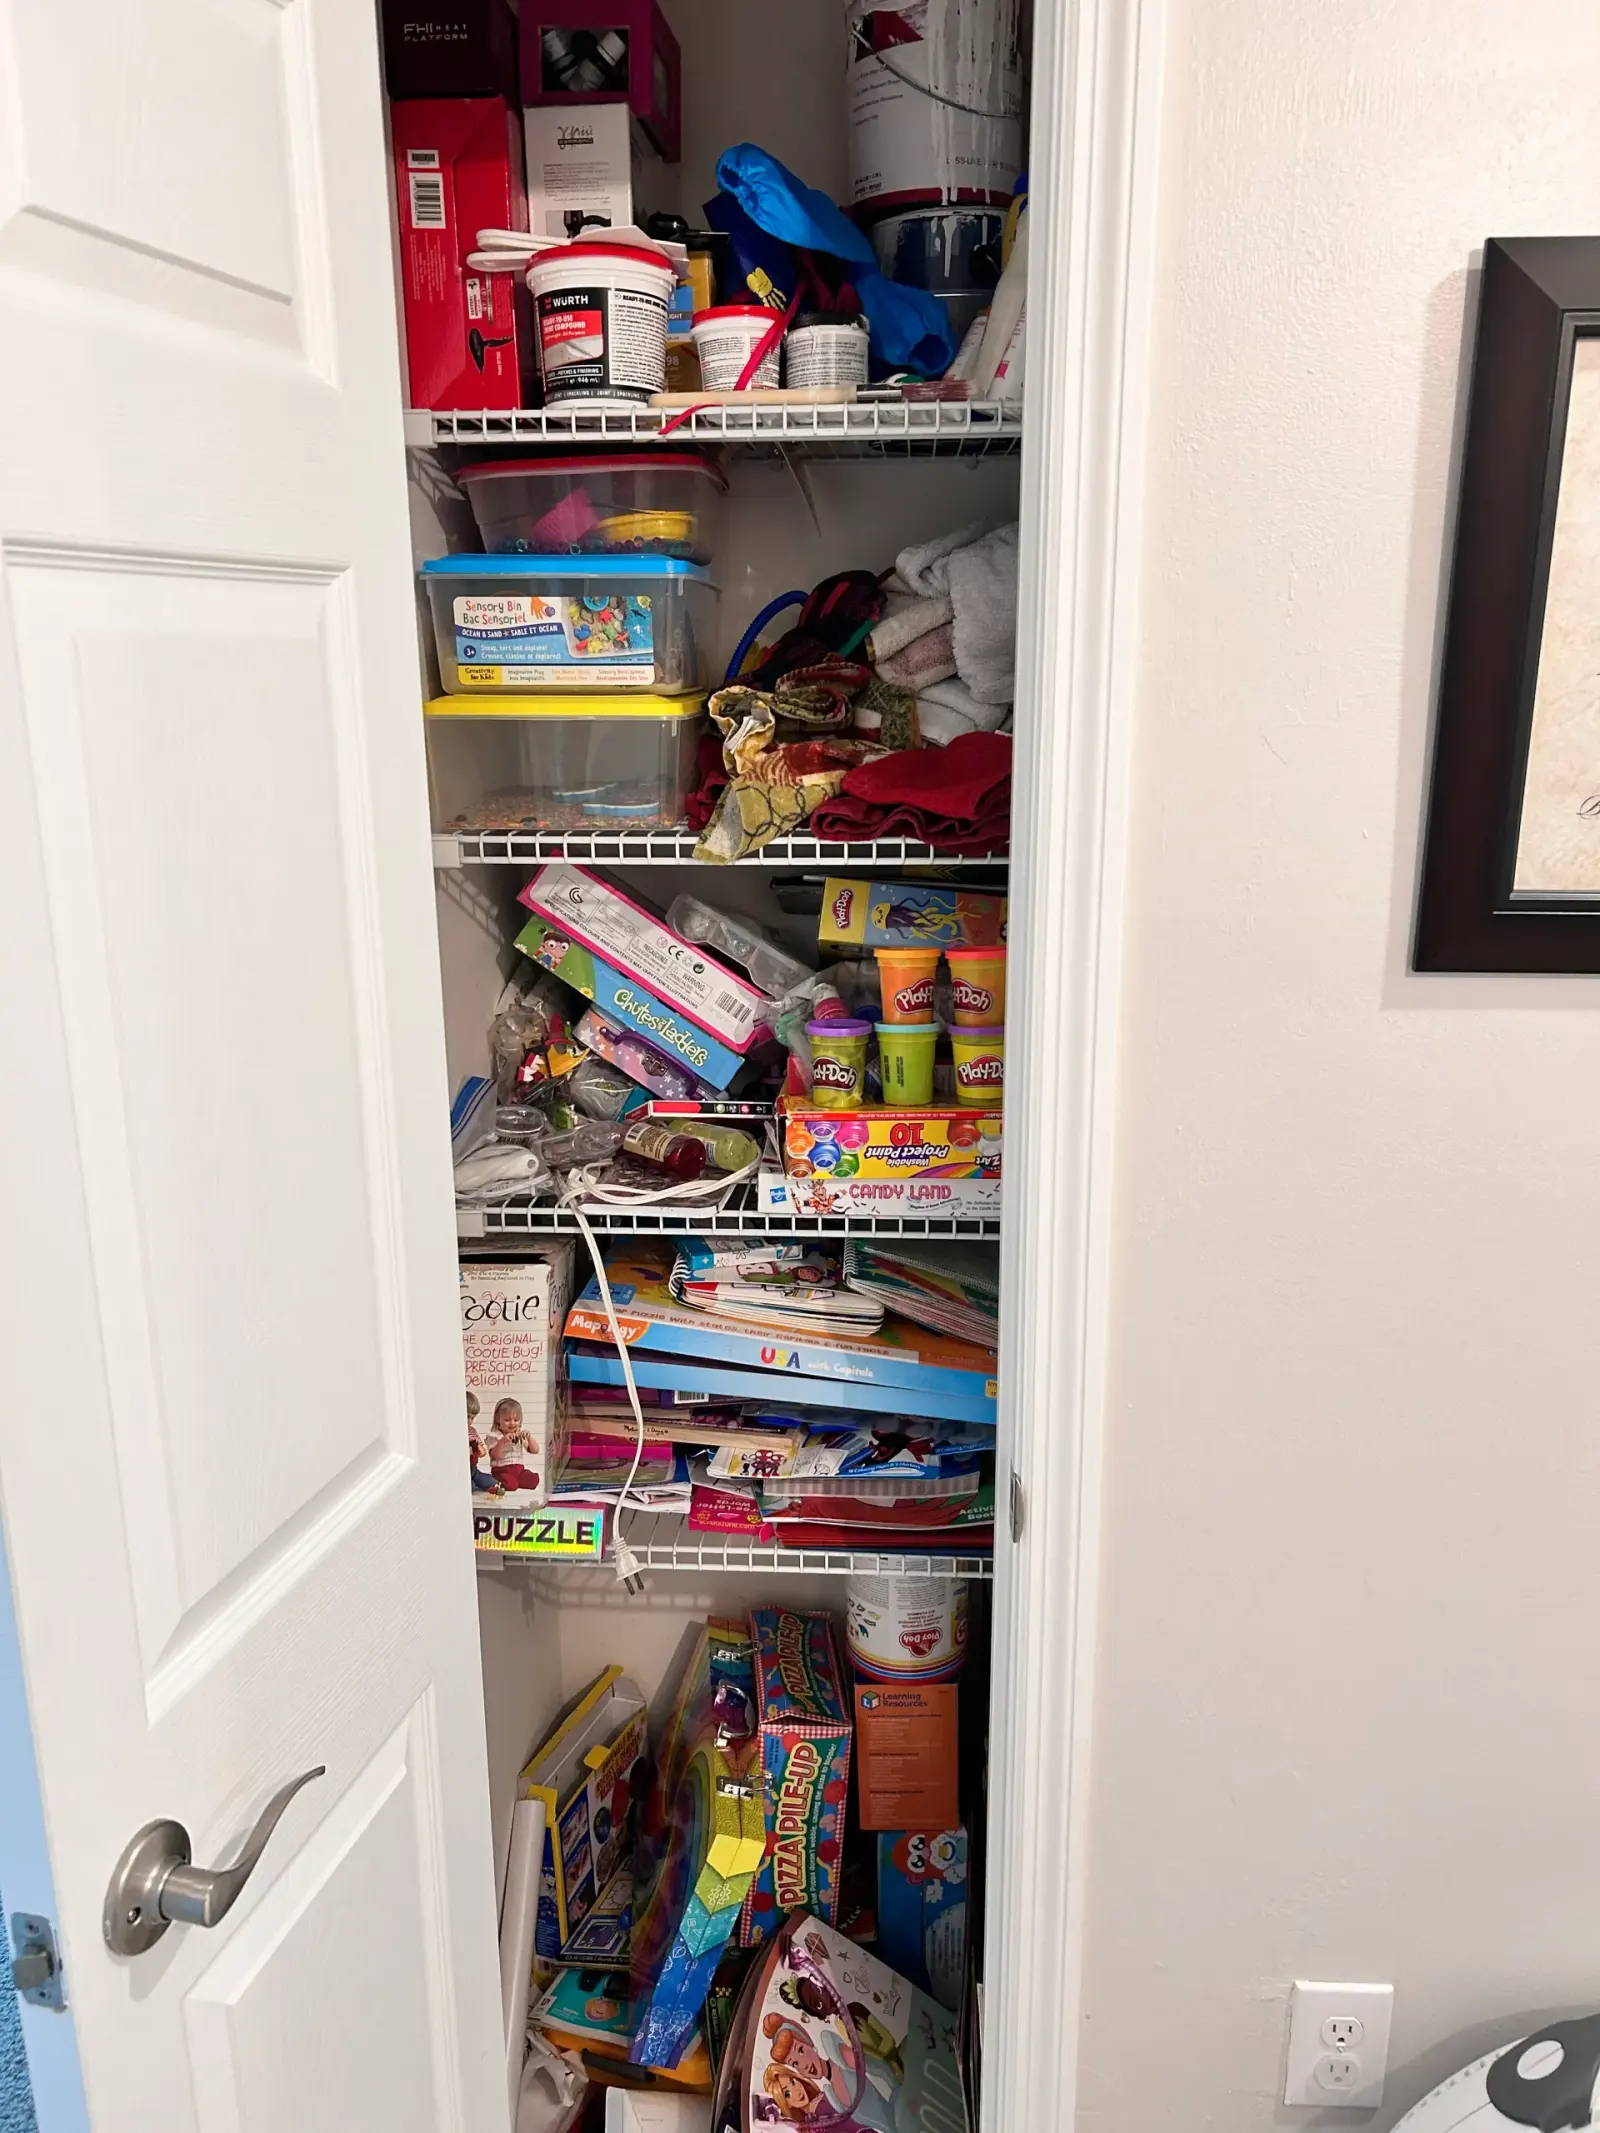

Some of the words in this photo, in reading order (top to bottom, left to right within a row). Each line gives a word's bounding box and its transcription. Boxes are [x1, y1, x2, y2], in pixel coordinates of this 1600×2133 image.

[403, 34, 468, 42] PLATFORM
[465, 600, 505, 613] Sensory
[507, 600, 522, 612] Bin
[463, 613, 480, 625] Bac
[482, 612, 527, 625] Sensoriel
[462, 629, 482, 637] OCEAN
[487, 630, 503, 638] SAND
[511, 628, 528, 637] SABLE
[837, 889, 854, 929] Play-Doh
[682, 972, 706, 992] WARNING
[614, 988, 660, 1030] Chutes
[658, 1017, 709, 1067] Ladders
[891, 1122, 924, 1146] 10
[866, 1146, 902, 1159] Paint
[903, 1145, 947, 1160] Project
[887, 1157, 930, 1167] Washable
[848, 1183, 905, 1200] CANDY
[910, 1184, 952, 1200] LAND
[463, 1334, 476, 1345] HE
[760, 1346, 801, 1369] USA
[834, 1362, 874, 1378] Capitals
[696, 1503, 759, 1512] ree-Letter
[716, 1500, 750, 1508] Words
[959, 1505, 994, 1515] Activi
[474, 1516, 595, 1546] PUZZLE
[781, 1655, 810, 1698] PIZZA
[882, 1692, 921, 1701] Learning
[882, 1700, 928, 1708] Resources
[778, 1744, 819, 1833] PILE-UP
[777, 1838, 804, 1905] PIZZA
